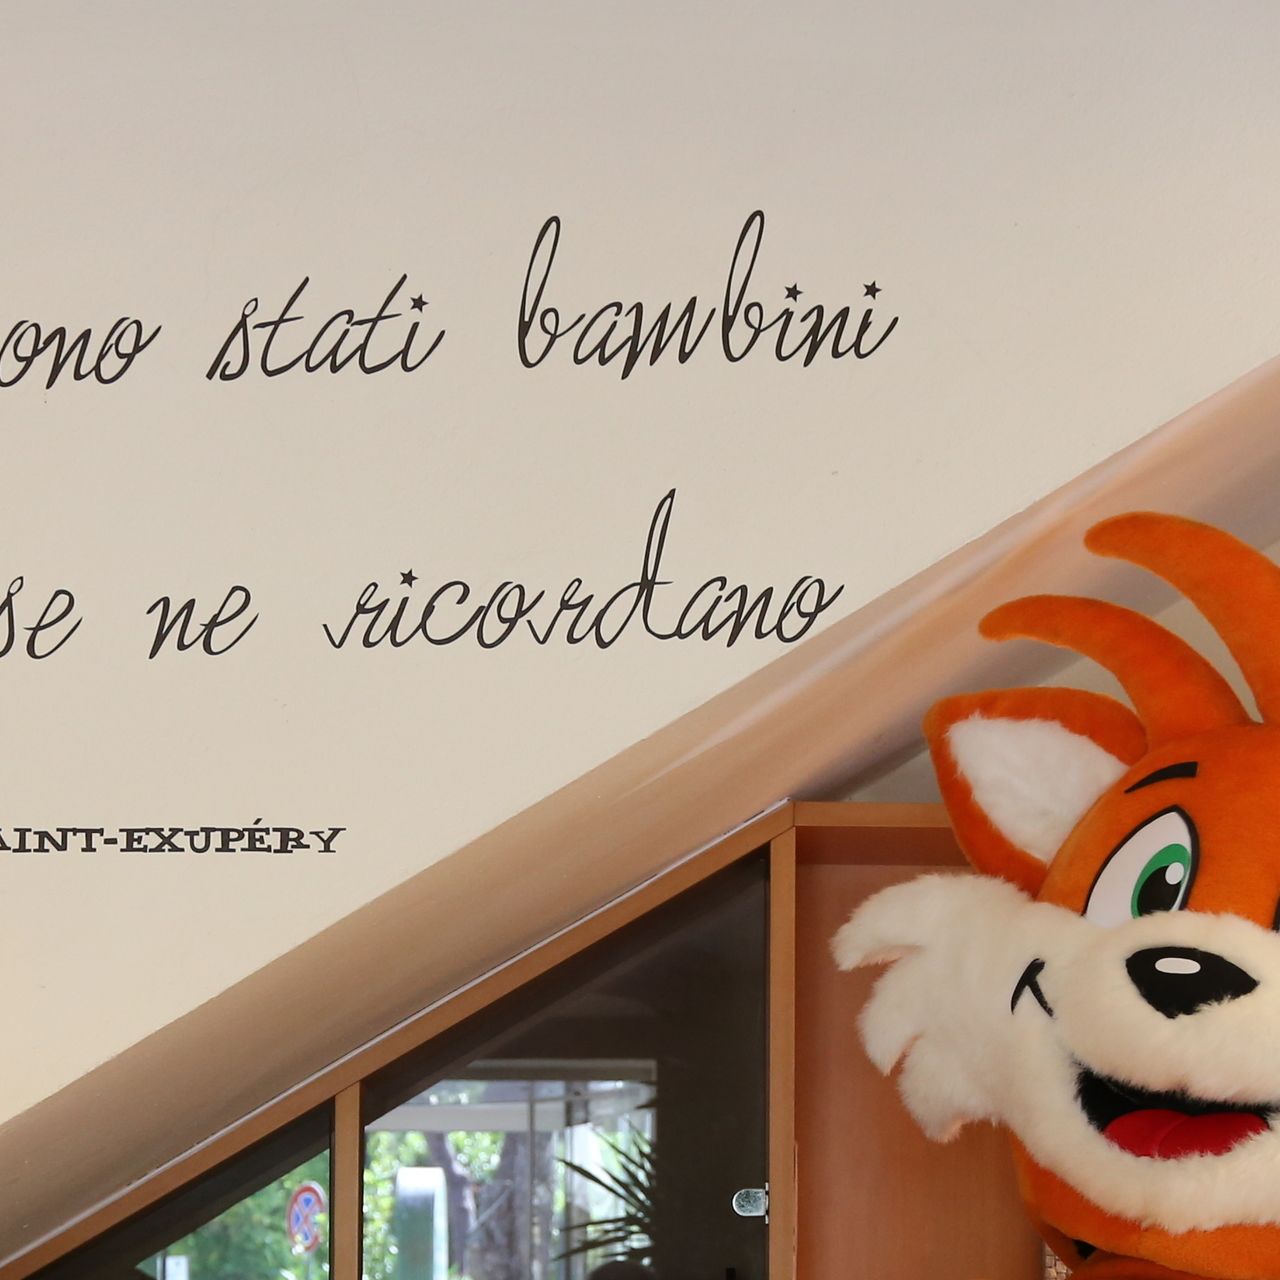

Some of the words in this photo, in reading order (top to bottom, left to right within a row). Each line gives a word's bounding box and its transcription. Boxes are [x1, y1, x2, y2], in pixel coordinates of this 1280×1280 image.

[205, 273, 446, 381] stati
[517, 209, 899, 381] bambini
[146, 585, 259, 660] ne
[322, 488, 845, 650] ricordano
